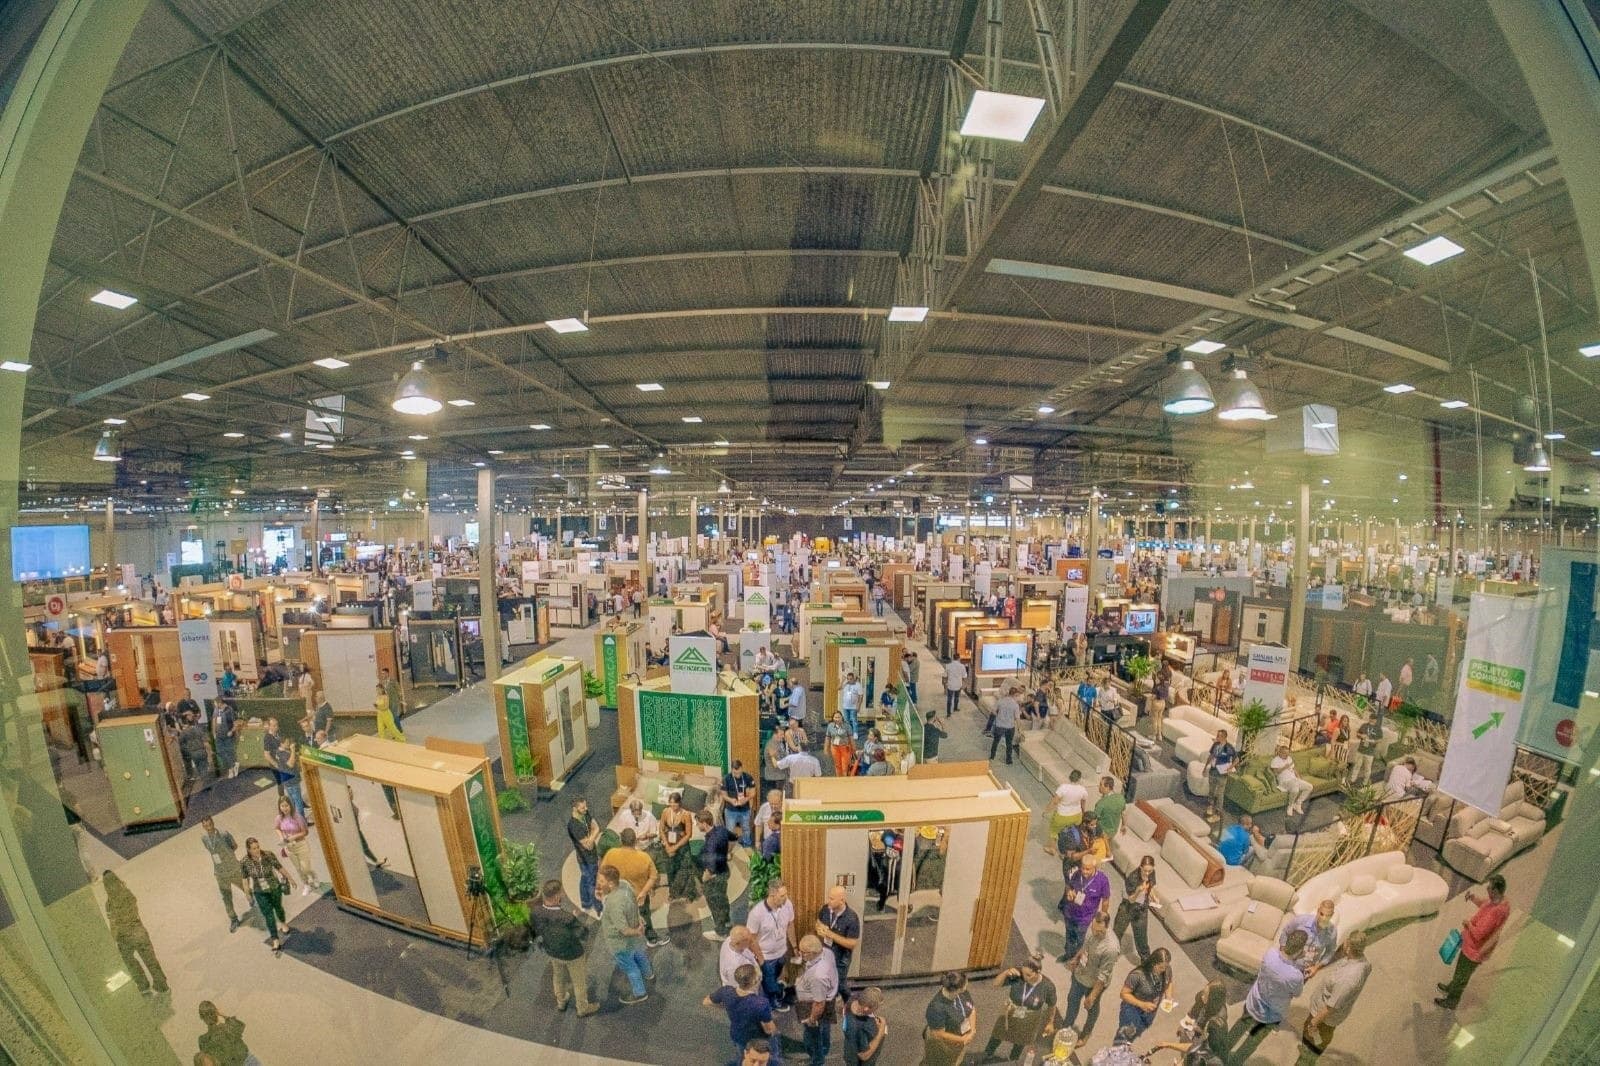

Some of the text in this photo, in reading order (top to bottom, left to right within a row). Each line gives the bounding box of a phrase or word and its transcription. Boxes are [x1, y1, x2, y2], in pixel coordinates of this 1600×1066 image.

[1472, 662, 1509, 678] PROJETO
[1471, 670, 1522, 690] COMPRADOR
[818, 813, 858, 821] ARAGUAIA
